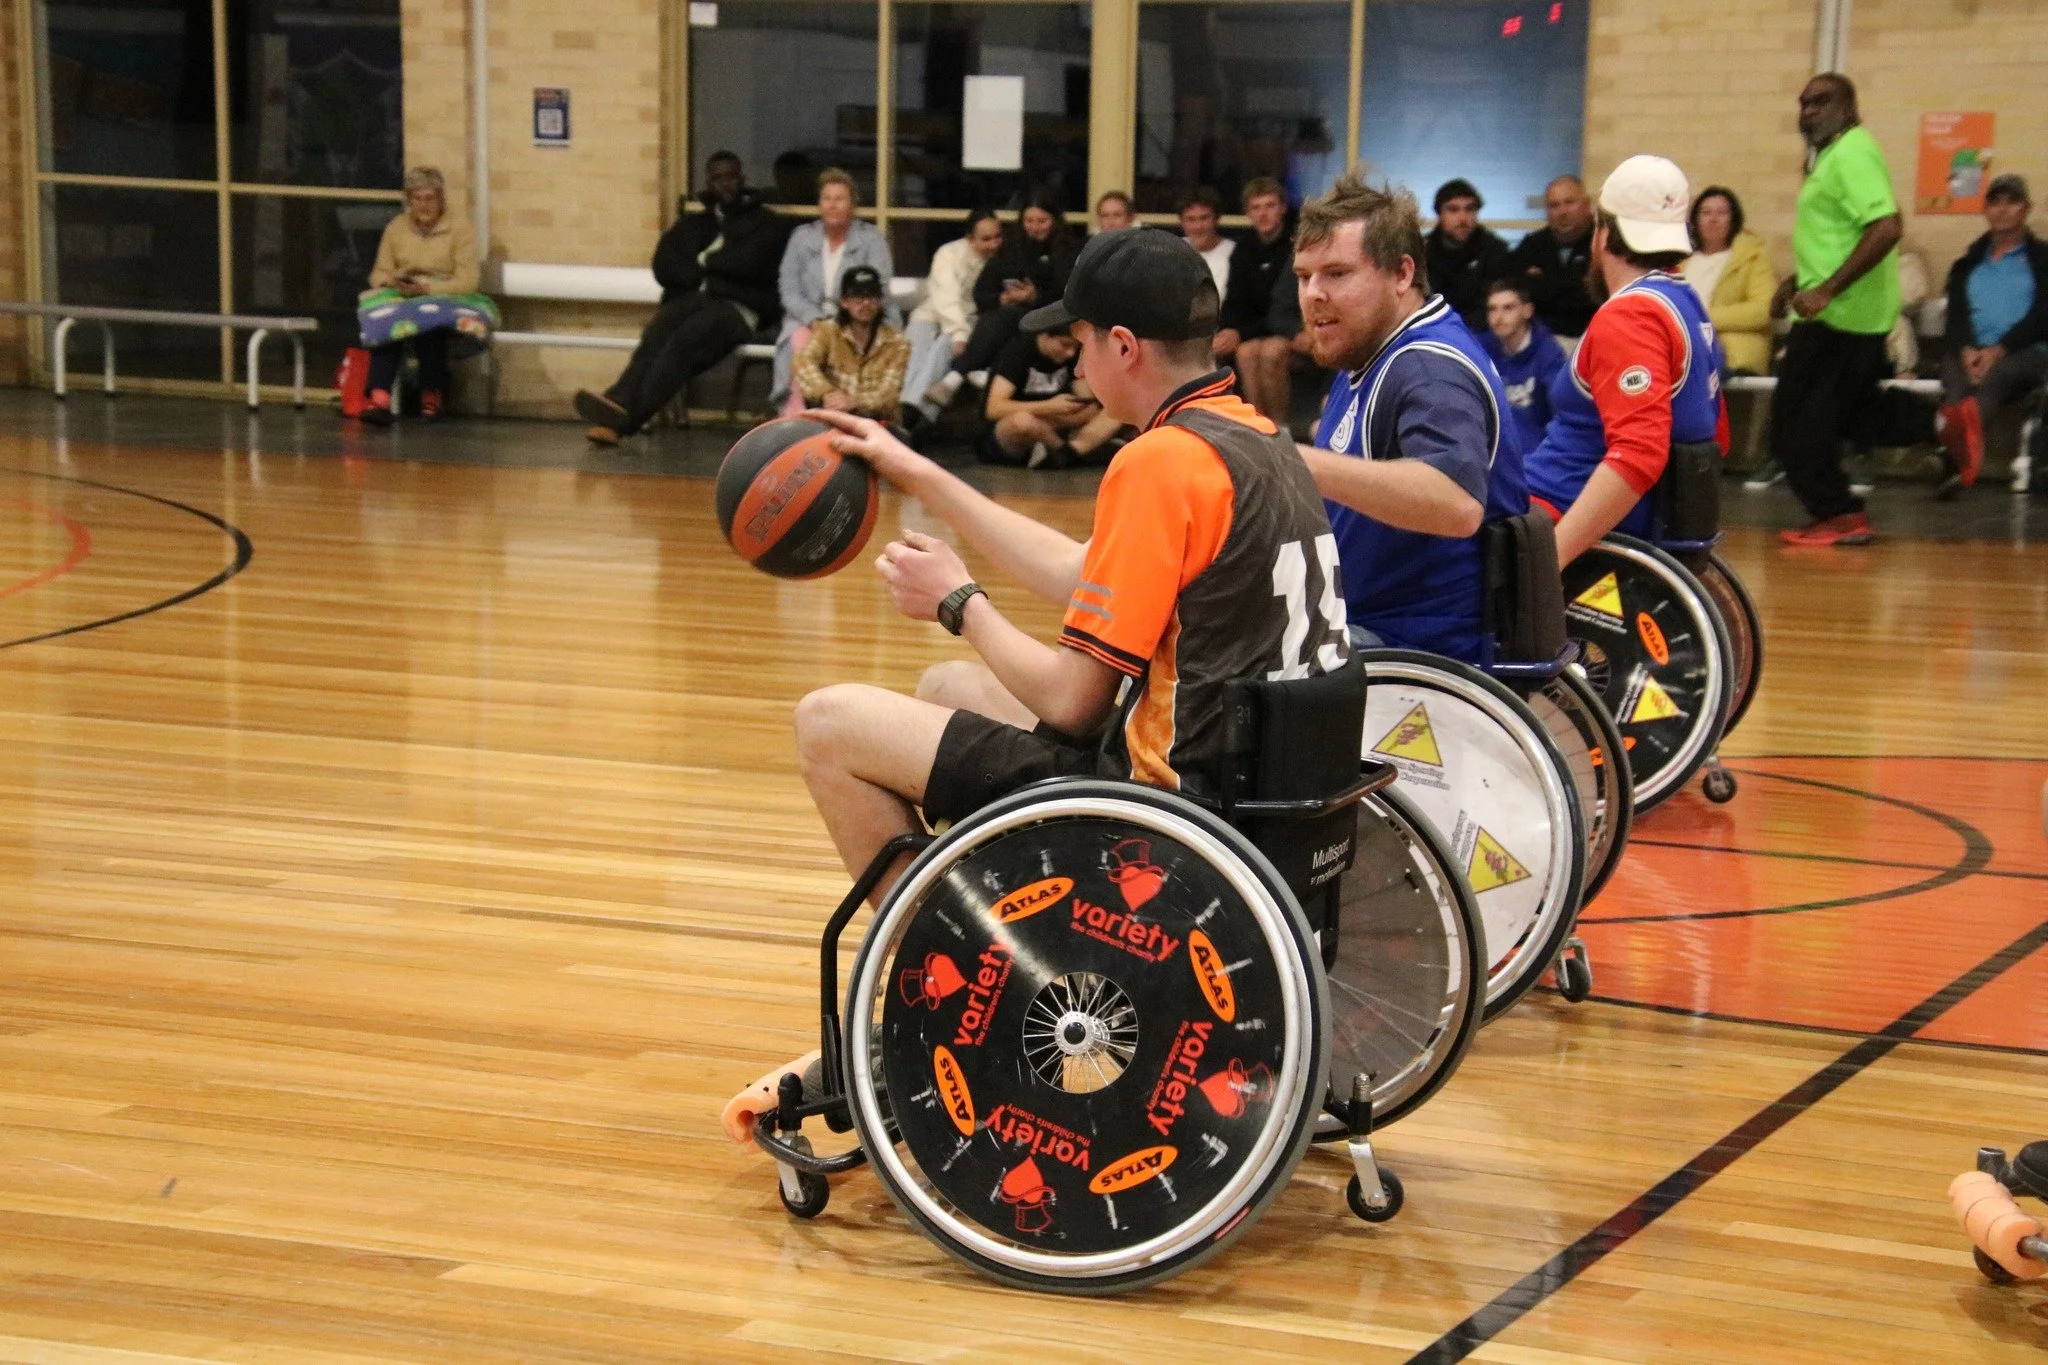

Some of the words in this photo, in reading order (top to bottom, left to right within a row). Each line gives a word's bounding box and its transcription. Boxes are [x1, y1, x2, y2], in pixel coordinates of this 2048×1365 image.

[1000, 883, 1062, 919] ATLAS
[1072, 899, 1180, 962] variety
[954, 943, 1014, 1046] variety
[1194, 945, 1228, 1010] ATLAS
[940, 1057, 971, 1121] ATLAS
[1147, 1021, 1213, 1136] variety
[984, 1105, 1089, 1172] variety
[1004, 1103, 1036, 1123] charity
[1034, 1117, 1077, 1141] children's
[1075, 1134, 1092, 1148] the
[1101, 1151, 1164, 1187] ATLAS
